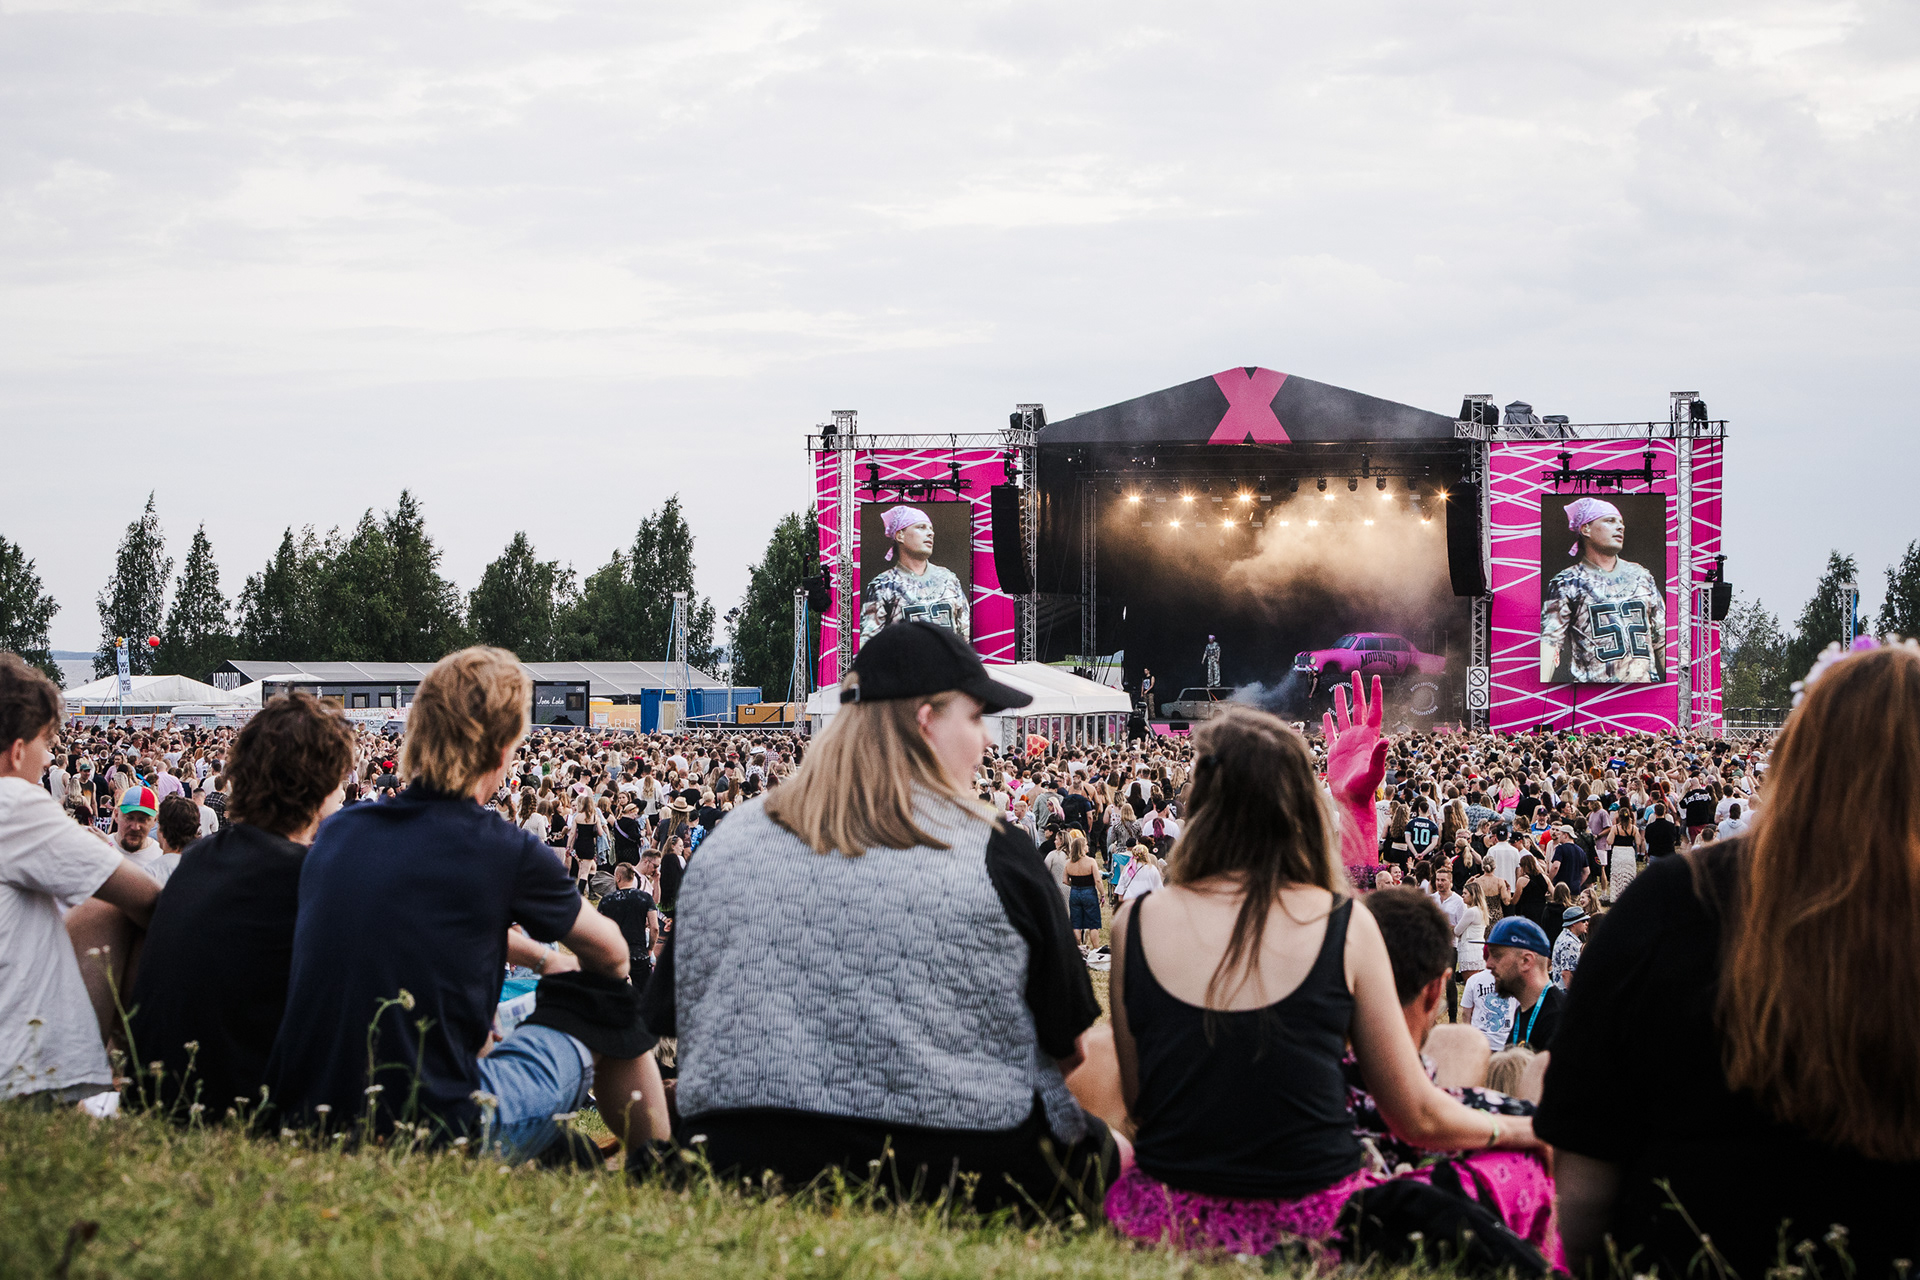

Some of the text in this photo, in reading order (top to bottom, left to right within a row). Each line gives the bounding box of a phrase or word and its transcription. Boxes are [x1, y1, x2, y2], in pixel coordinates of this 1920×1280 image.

[1588, 600, 1652, 663] 52
[1361, 651, 1398, 669] MOUHOUS
[1413, 827, 1430, 845] 10
